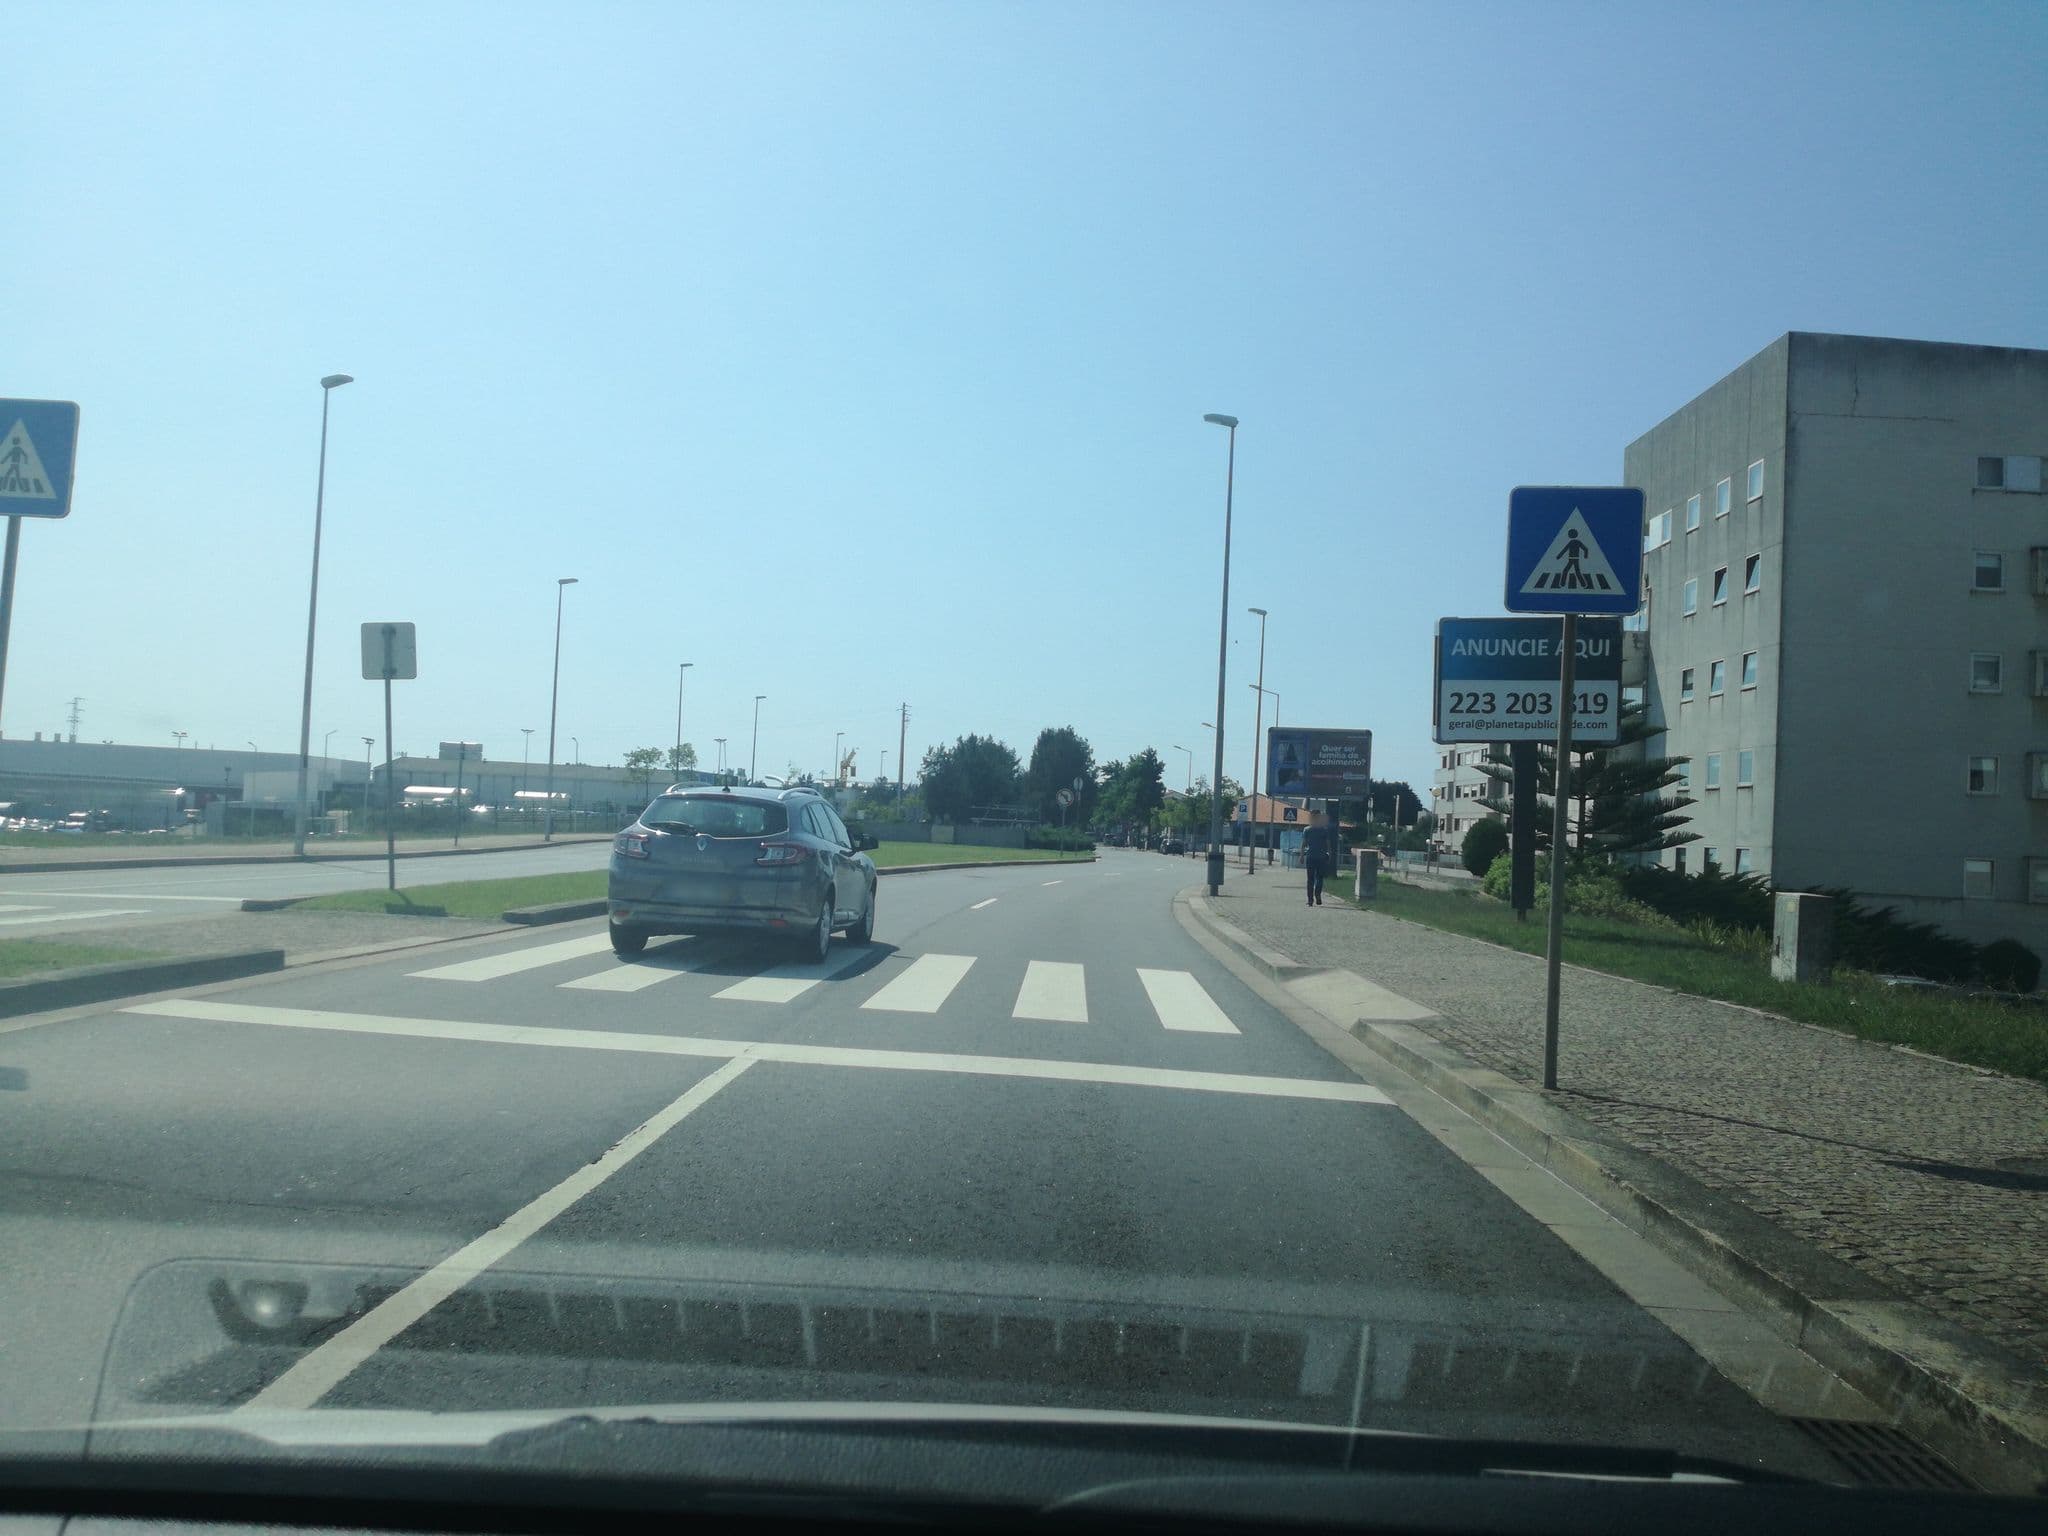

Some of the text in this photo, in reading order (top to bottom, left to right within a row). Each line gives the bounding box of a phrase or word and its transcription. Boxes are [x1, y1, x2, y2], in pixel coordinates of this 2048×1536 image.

[1451, 638, 1610, 658] ANUNCIE AQUI
[1449, 692, 1497, 714] 223
[1505, 692, 1553, 714] 203
[1448, 719, 1608, 730] geral@planetapublicide.com
